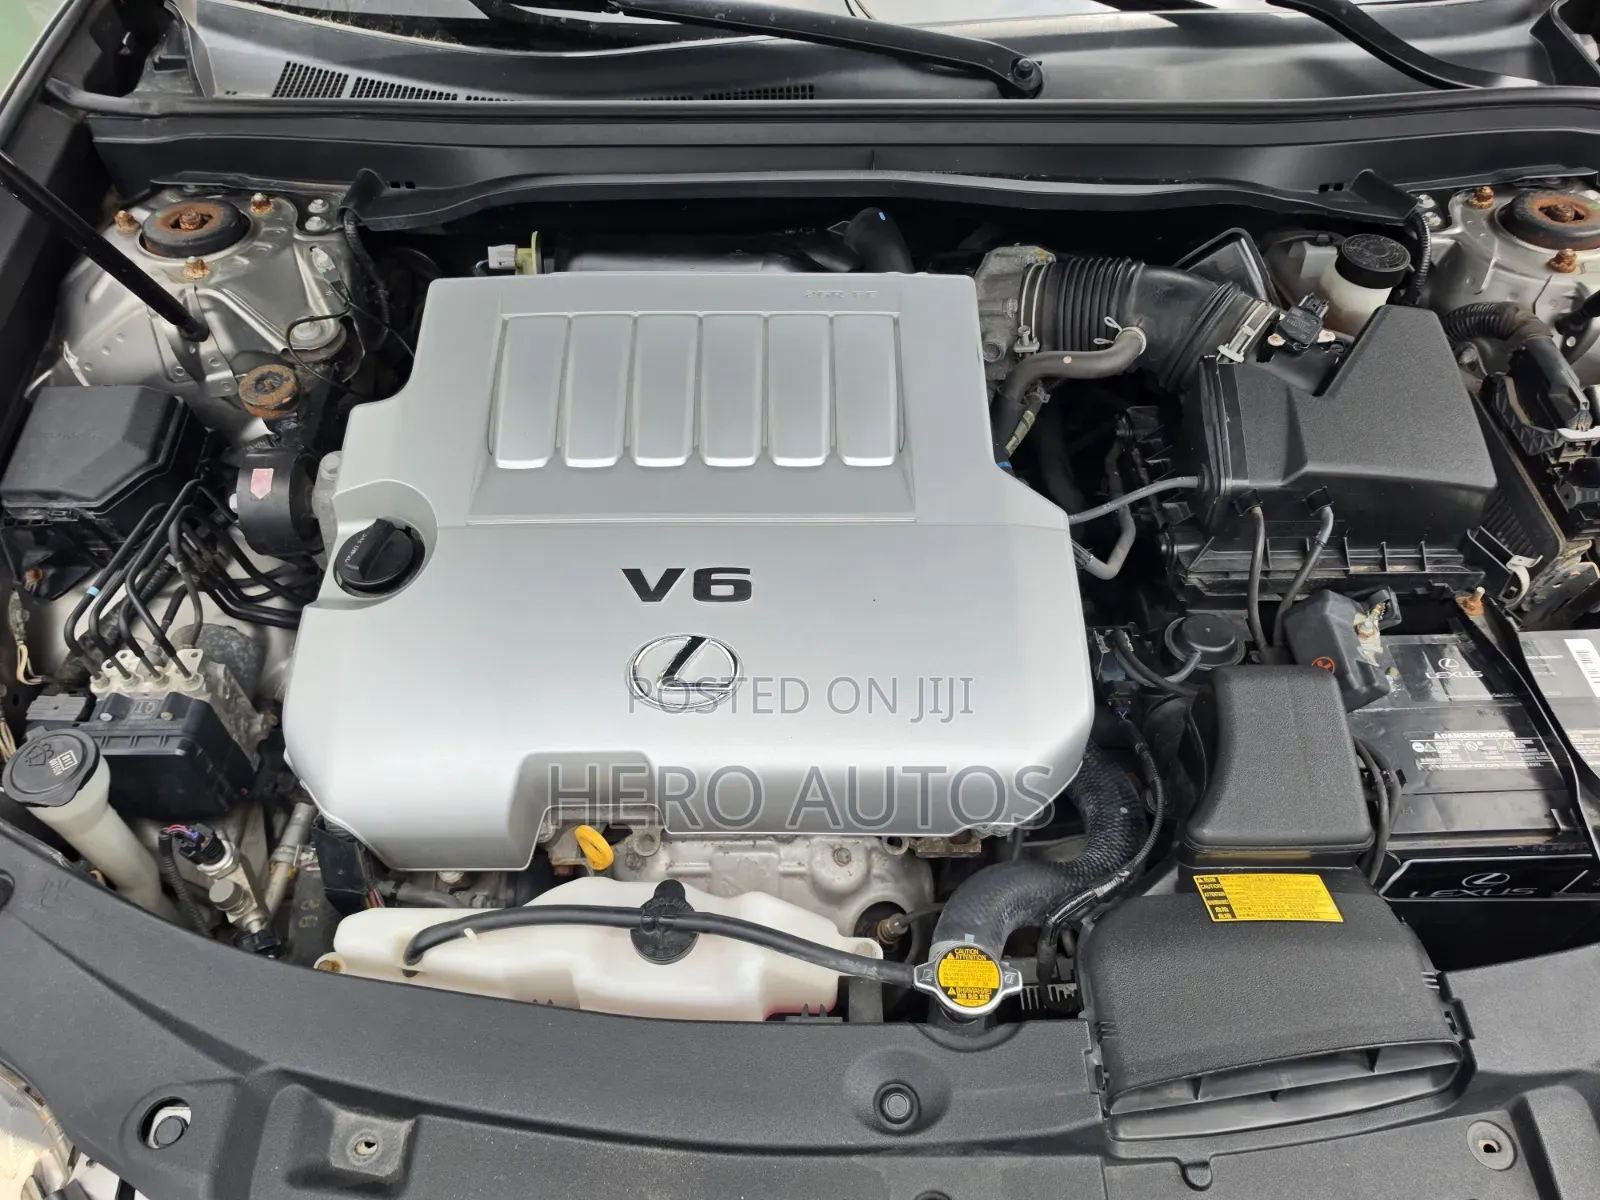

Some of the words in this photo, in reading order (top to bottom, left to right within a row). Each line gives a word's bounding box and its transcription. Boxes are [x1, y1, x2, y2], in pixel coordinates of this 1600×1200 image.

[621, 567, 753, 602] V6
[1425, 671, 1484, 679] LEXUS
[1410, 887, 1538, 898] LEXUS
